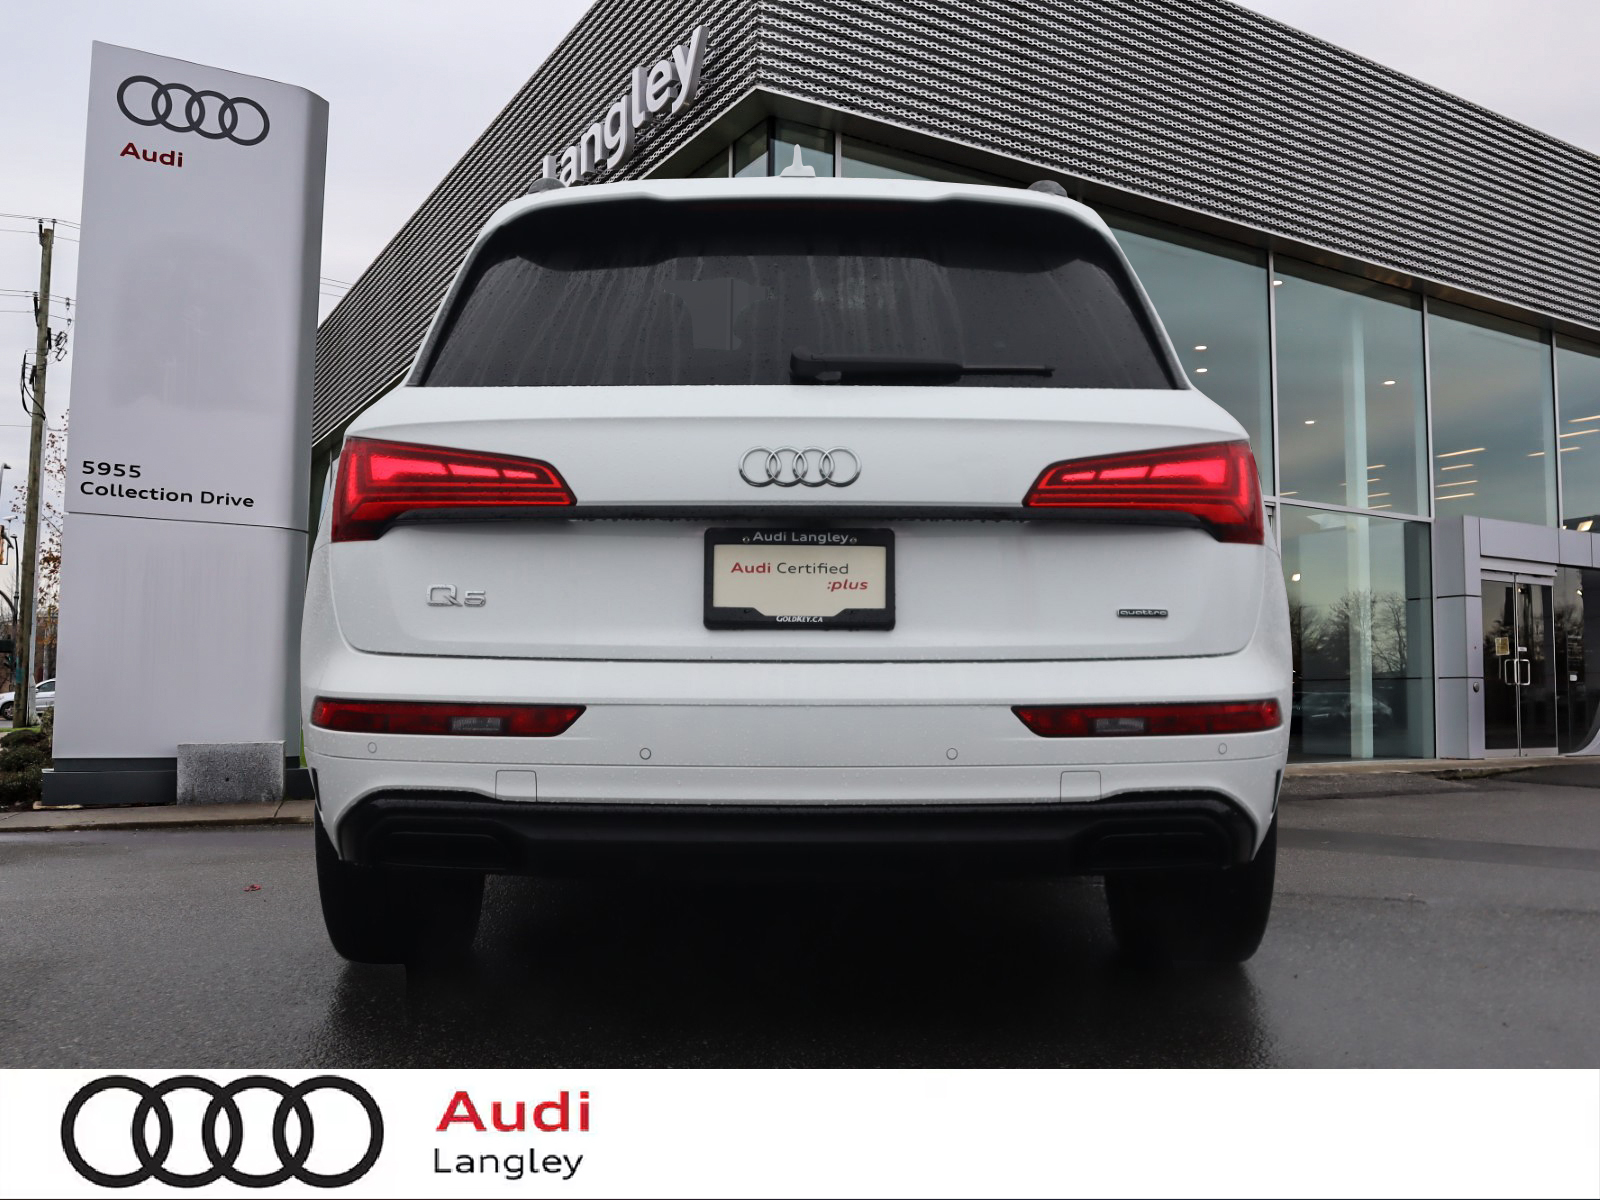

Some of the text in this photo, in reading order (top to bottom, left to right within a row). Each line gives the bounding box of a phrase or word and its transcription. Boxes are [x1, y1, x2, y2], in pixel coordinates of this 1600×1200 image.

[120, 142, 183, 168] Audi
[82, 460, 142, 479] 5955
[80, 481, 255, 508] Collection Drive
[752, 531, 849, 544] Audi Langley
[731, 562, 849, 574] Audi Certified
[827, 579, 868, 592] :plus
[426, 584, 487, 607] Q5
[1119, 609, 1168, 617] quattro
